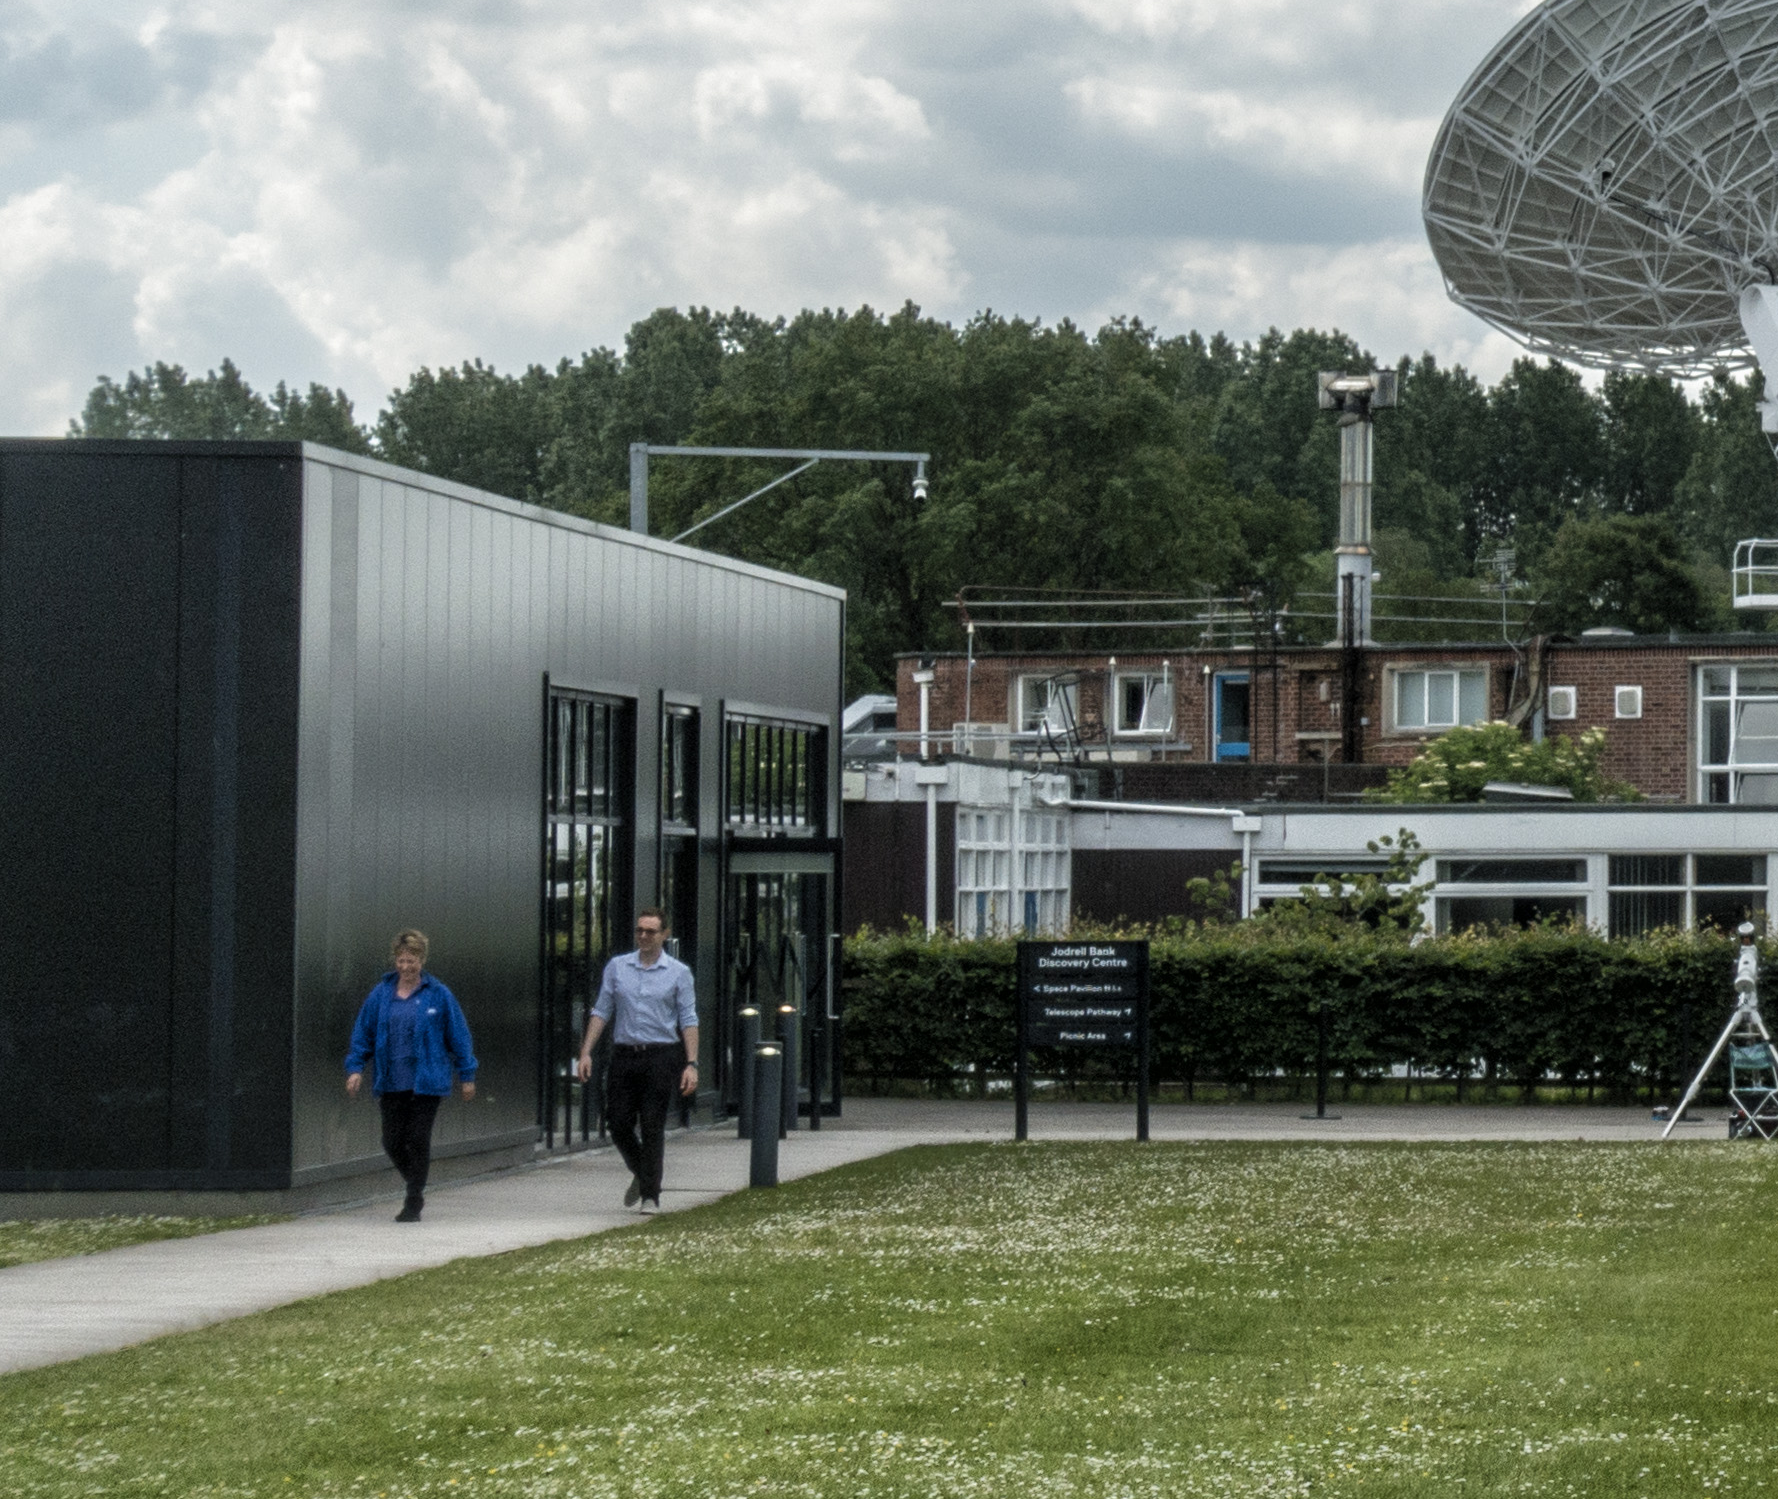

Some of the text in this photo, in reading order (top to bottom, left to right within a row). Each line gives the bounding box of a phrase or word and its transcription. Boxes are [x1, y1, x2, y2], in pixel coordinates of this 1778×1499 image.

[1051, 946, 1116, 956] Jodrell Bank
[1039, 958, 1128, 969] Discovery Centre
[1043, 985, 1069, 994] Space
[1044, 1008, 1121, 1017] Telescope Pathway
[1060, 1032, 1106, 1040] Picnic Area
